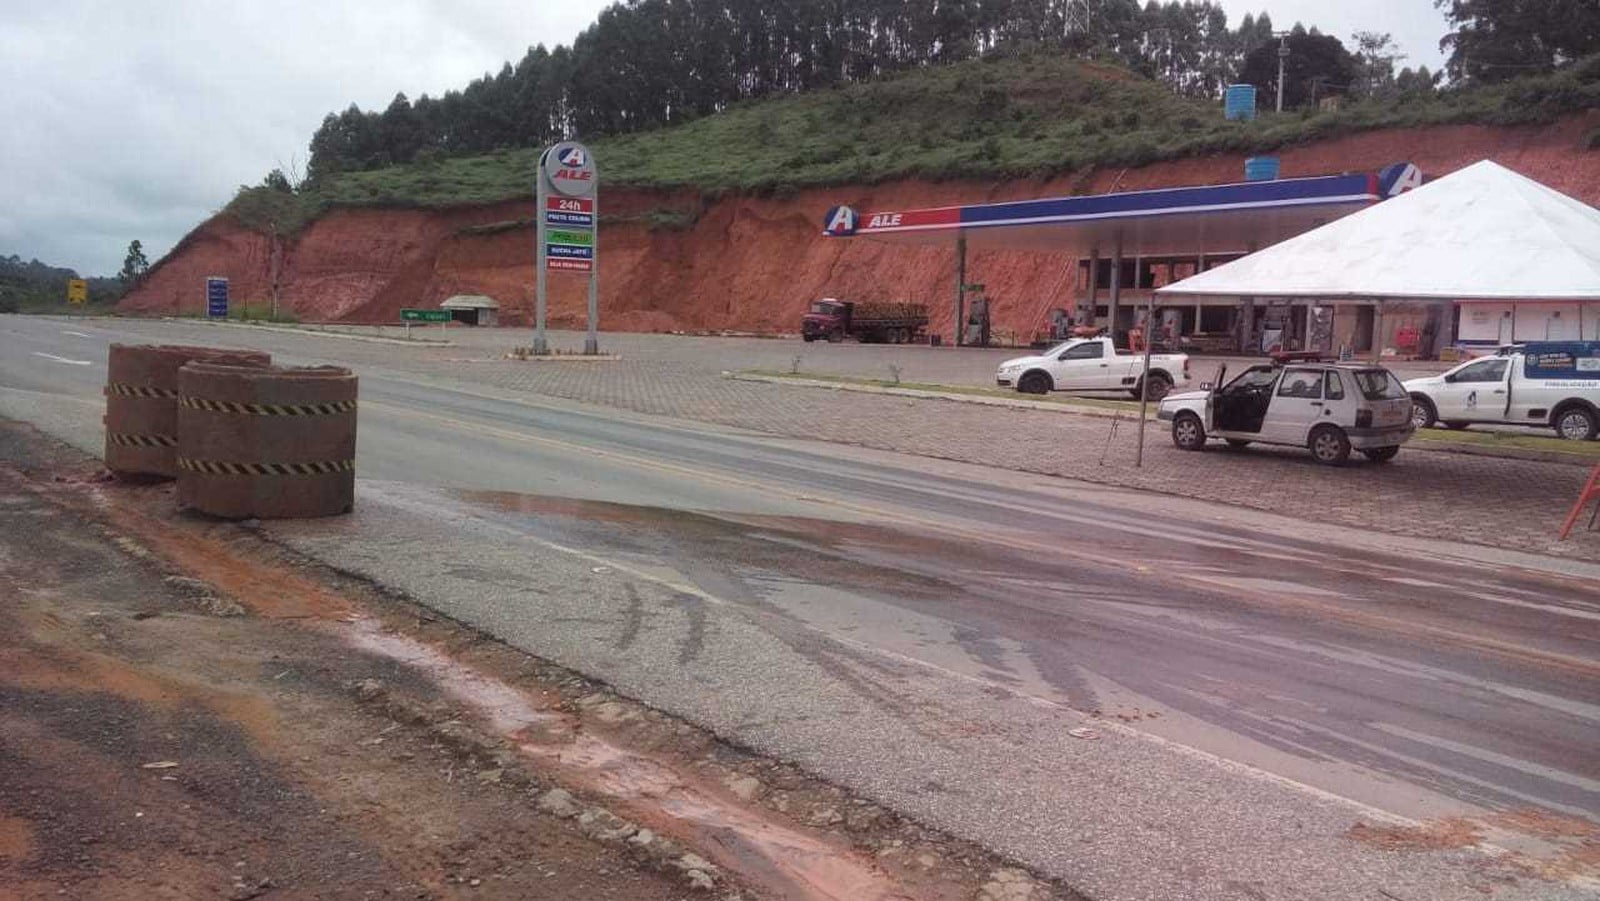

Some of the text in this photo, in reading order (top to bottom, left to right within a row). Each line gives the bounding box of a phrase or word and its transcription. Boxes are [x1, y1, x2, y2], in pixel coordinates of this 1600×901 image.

[552, 169, 592, 181] ALE
[559, 199, 581, 211] 24h
[868, 213, 903, 228] ALE
